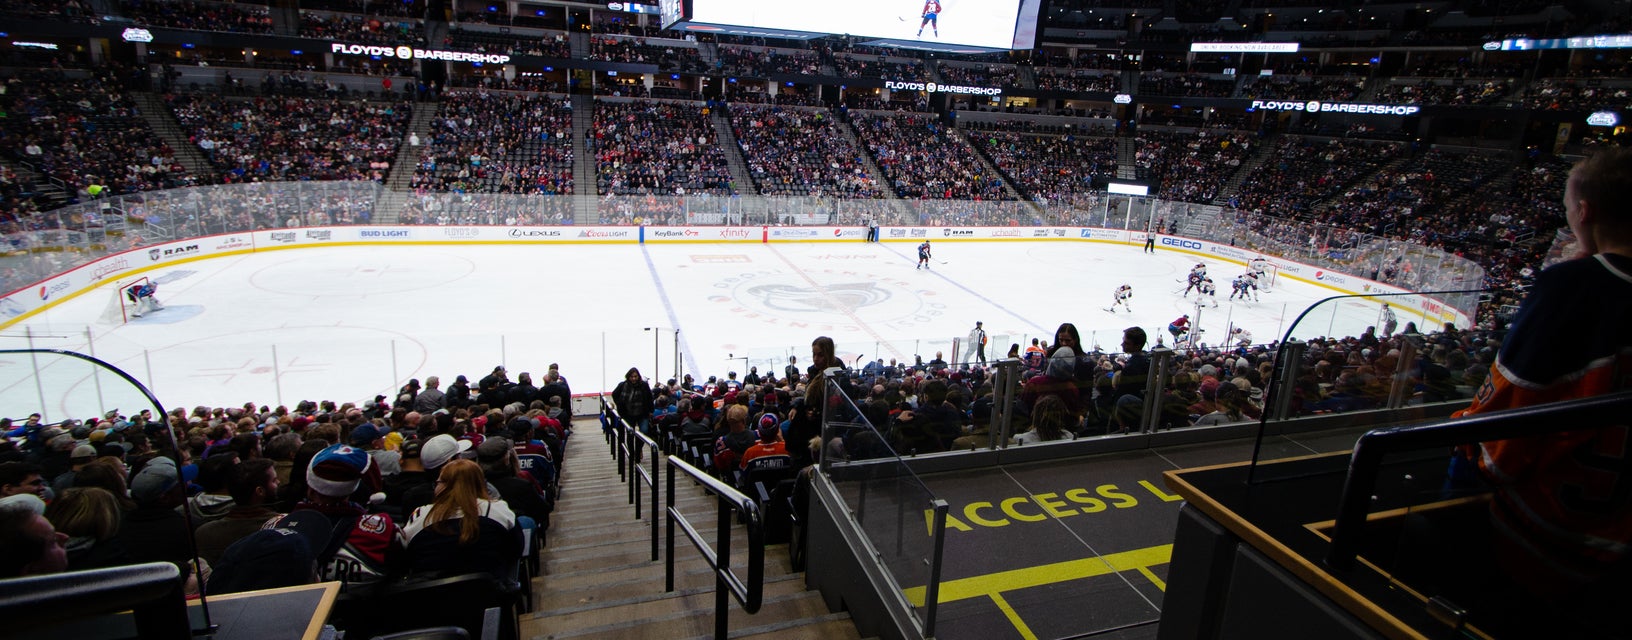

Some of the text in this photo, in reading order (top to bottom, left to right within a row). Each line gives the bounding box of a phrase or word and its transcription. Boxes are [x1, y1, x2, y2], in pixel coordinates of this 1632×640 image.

[331, 43, 510, 65] FLOYD'S BARBERSHOP
[885, 81, 1001, 95] FLOYD'S BARBERSHOP
[1251, 101, 1418, 115] FLOYD'S BARBERSHOP
[586, 229, 608, 237] Coors
[720, 228, 750, 239] xfinity
[843, 230, 861, 238] pepsi
[1162, 237, 1202, 250] GEICO
[164, 245, 199, 256] RAM
[1325, 274, 1345, 285] pepsi
[924, 484, 1139, 537] ACCESS
